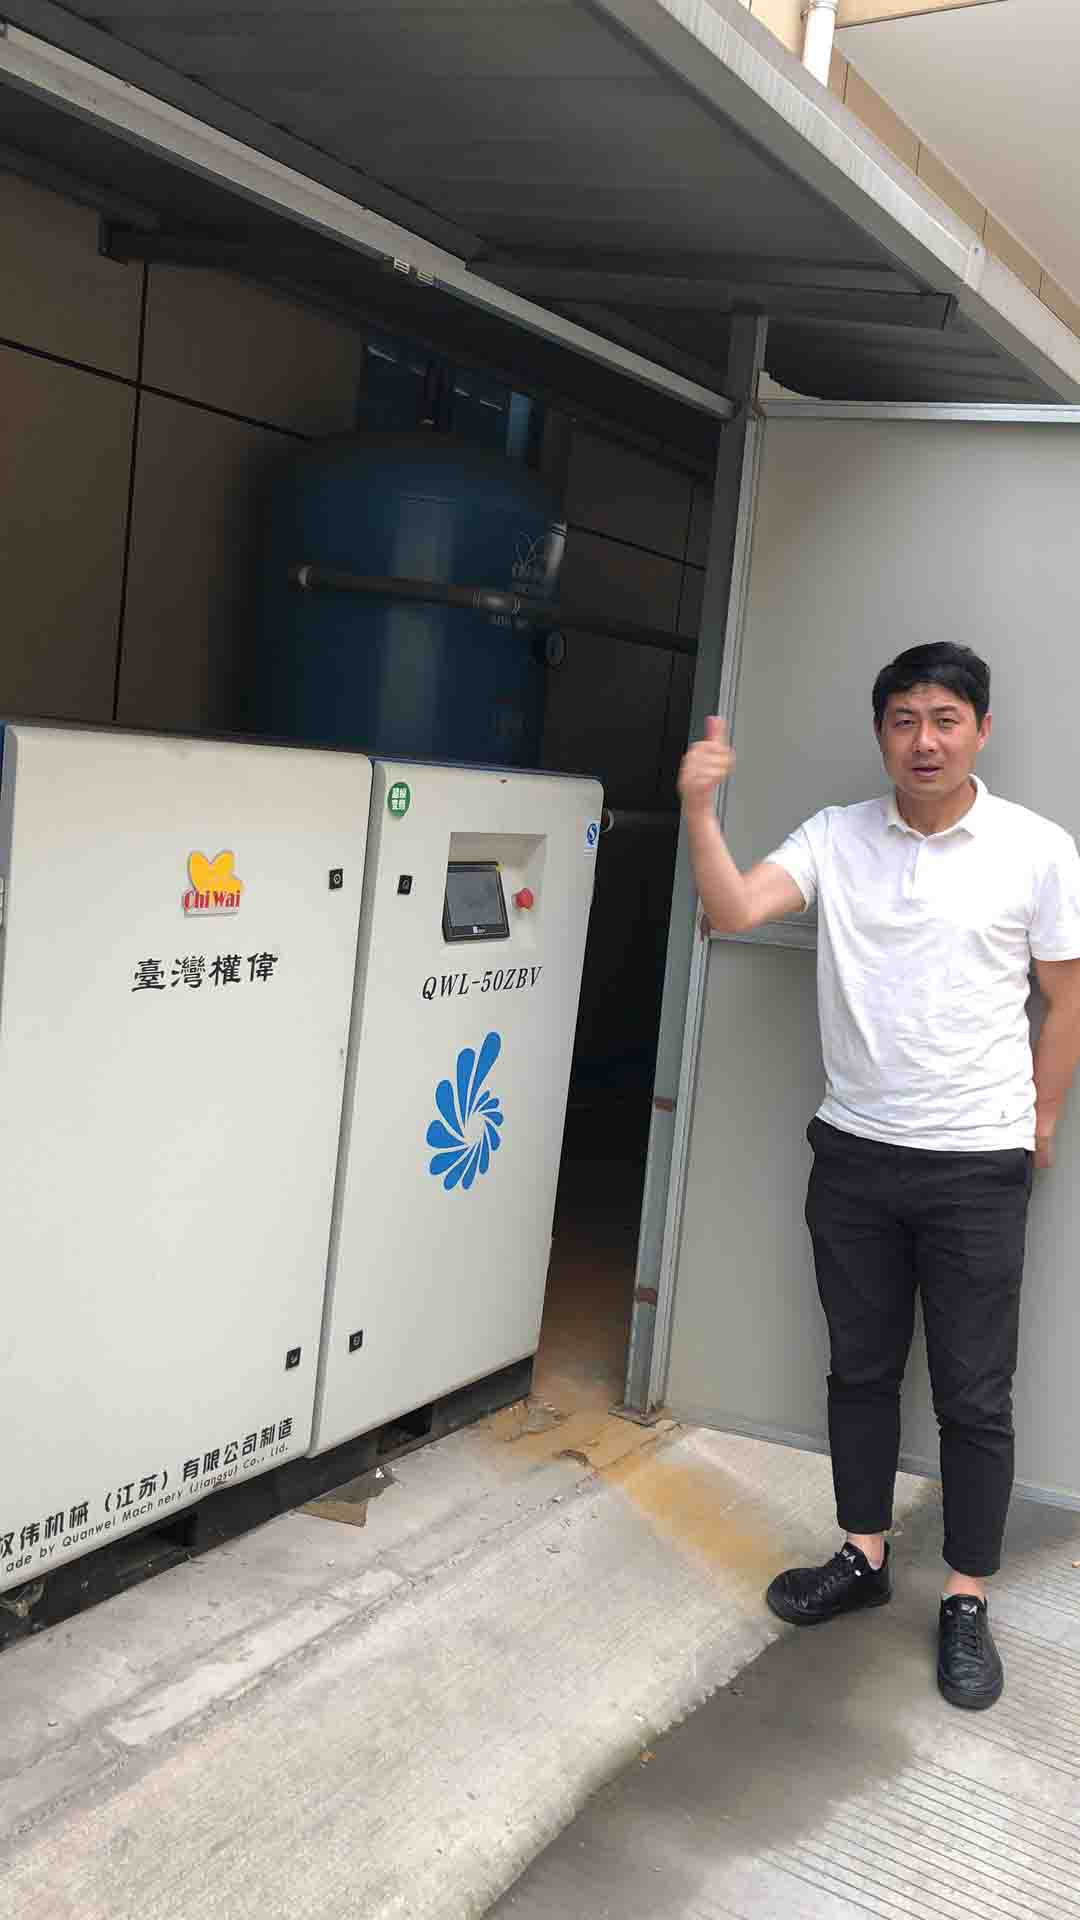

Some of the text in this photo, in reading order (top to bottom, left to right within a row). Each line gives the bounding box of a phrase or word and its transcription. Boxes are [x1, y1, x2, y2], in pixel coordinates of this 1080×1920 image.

[182, 889, 240, 912] Chi Wai
[131, 951, 279, 992] 臺灣權偉
[422, 966, 543, 1001] QWL-50ZBV
[6, 1553, 33, 1573] ade
